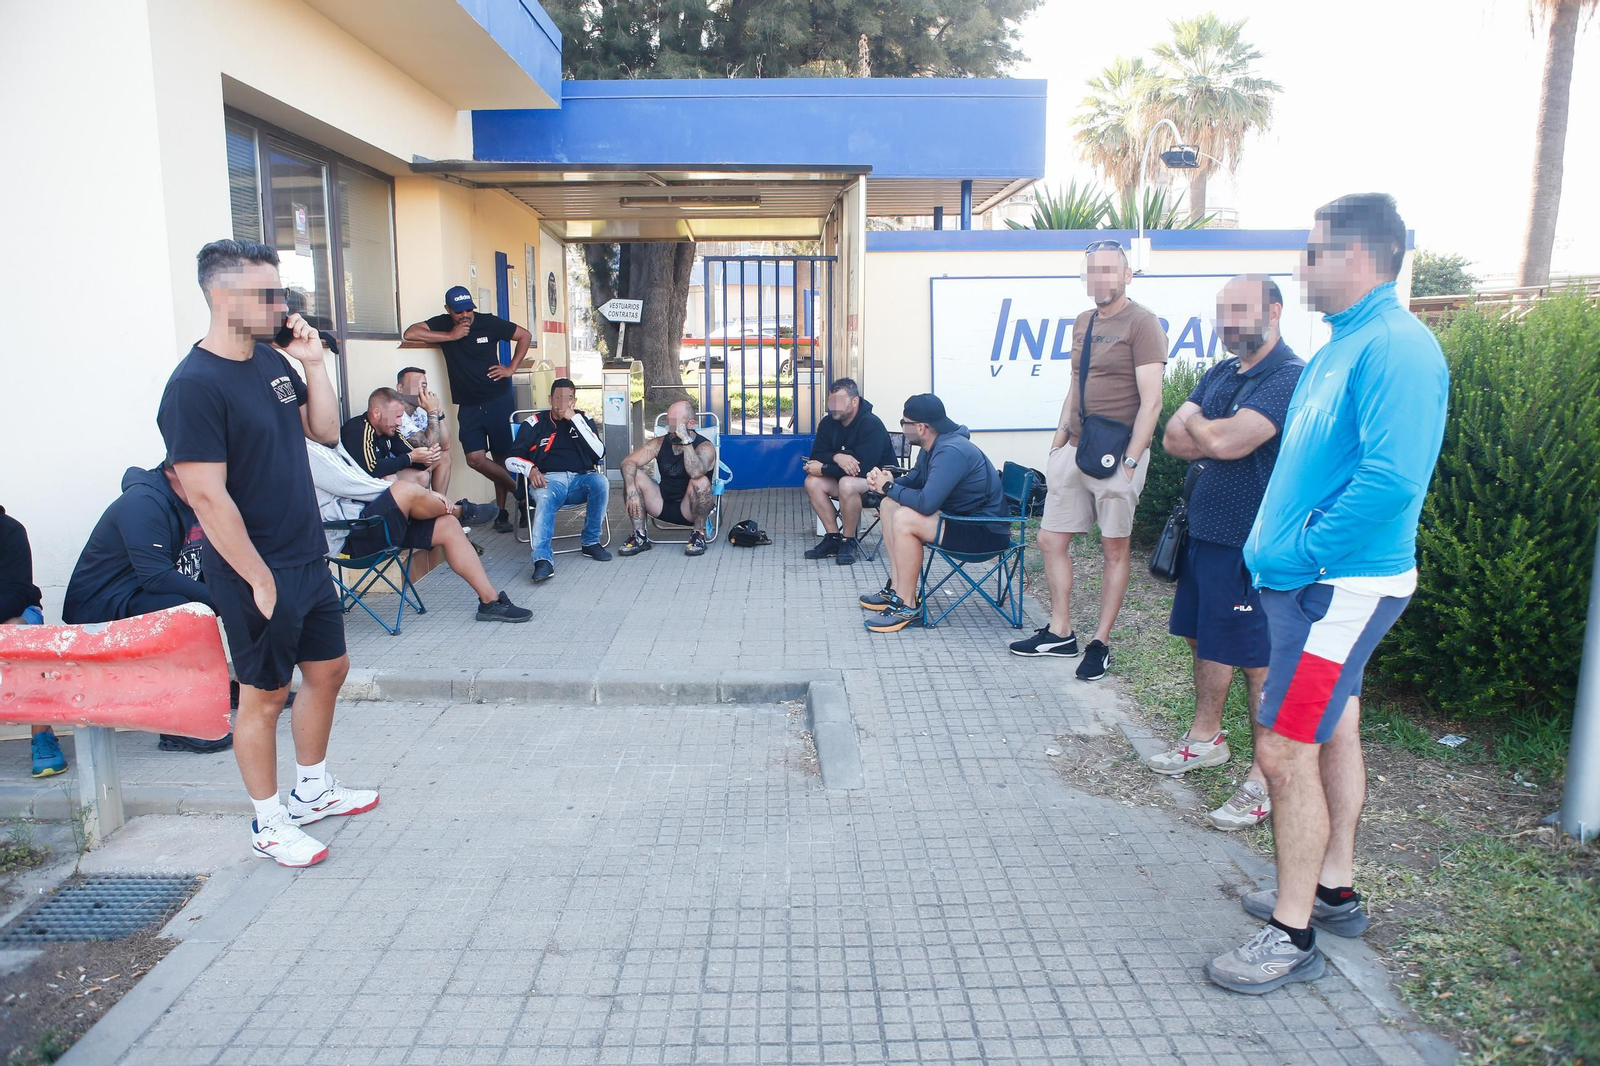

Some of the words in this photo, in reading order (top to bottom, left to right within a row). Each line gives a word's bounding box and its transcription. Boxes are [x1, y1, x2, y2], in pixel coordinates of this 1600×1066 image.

[609, 302, 640, 311] VESTUARIOS
[607, 310, 639, 319] CONTRATAS
[1233, 604, 1253, 612] FILA
